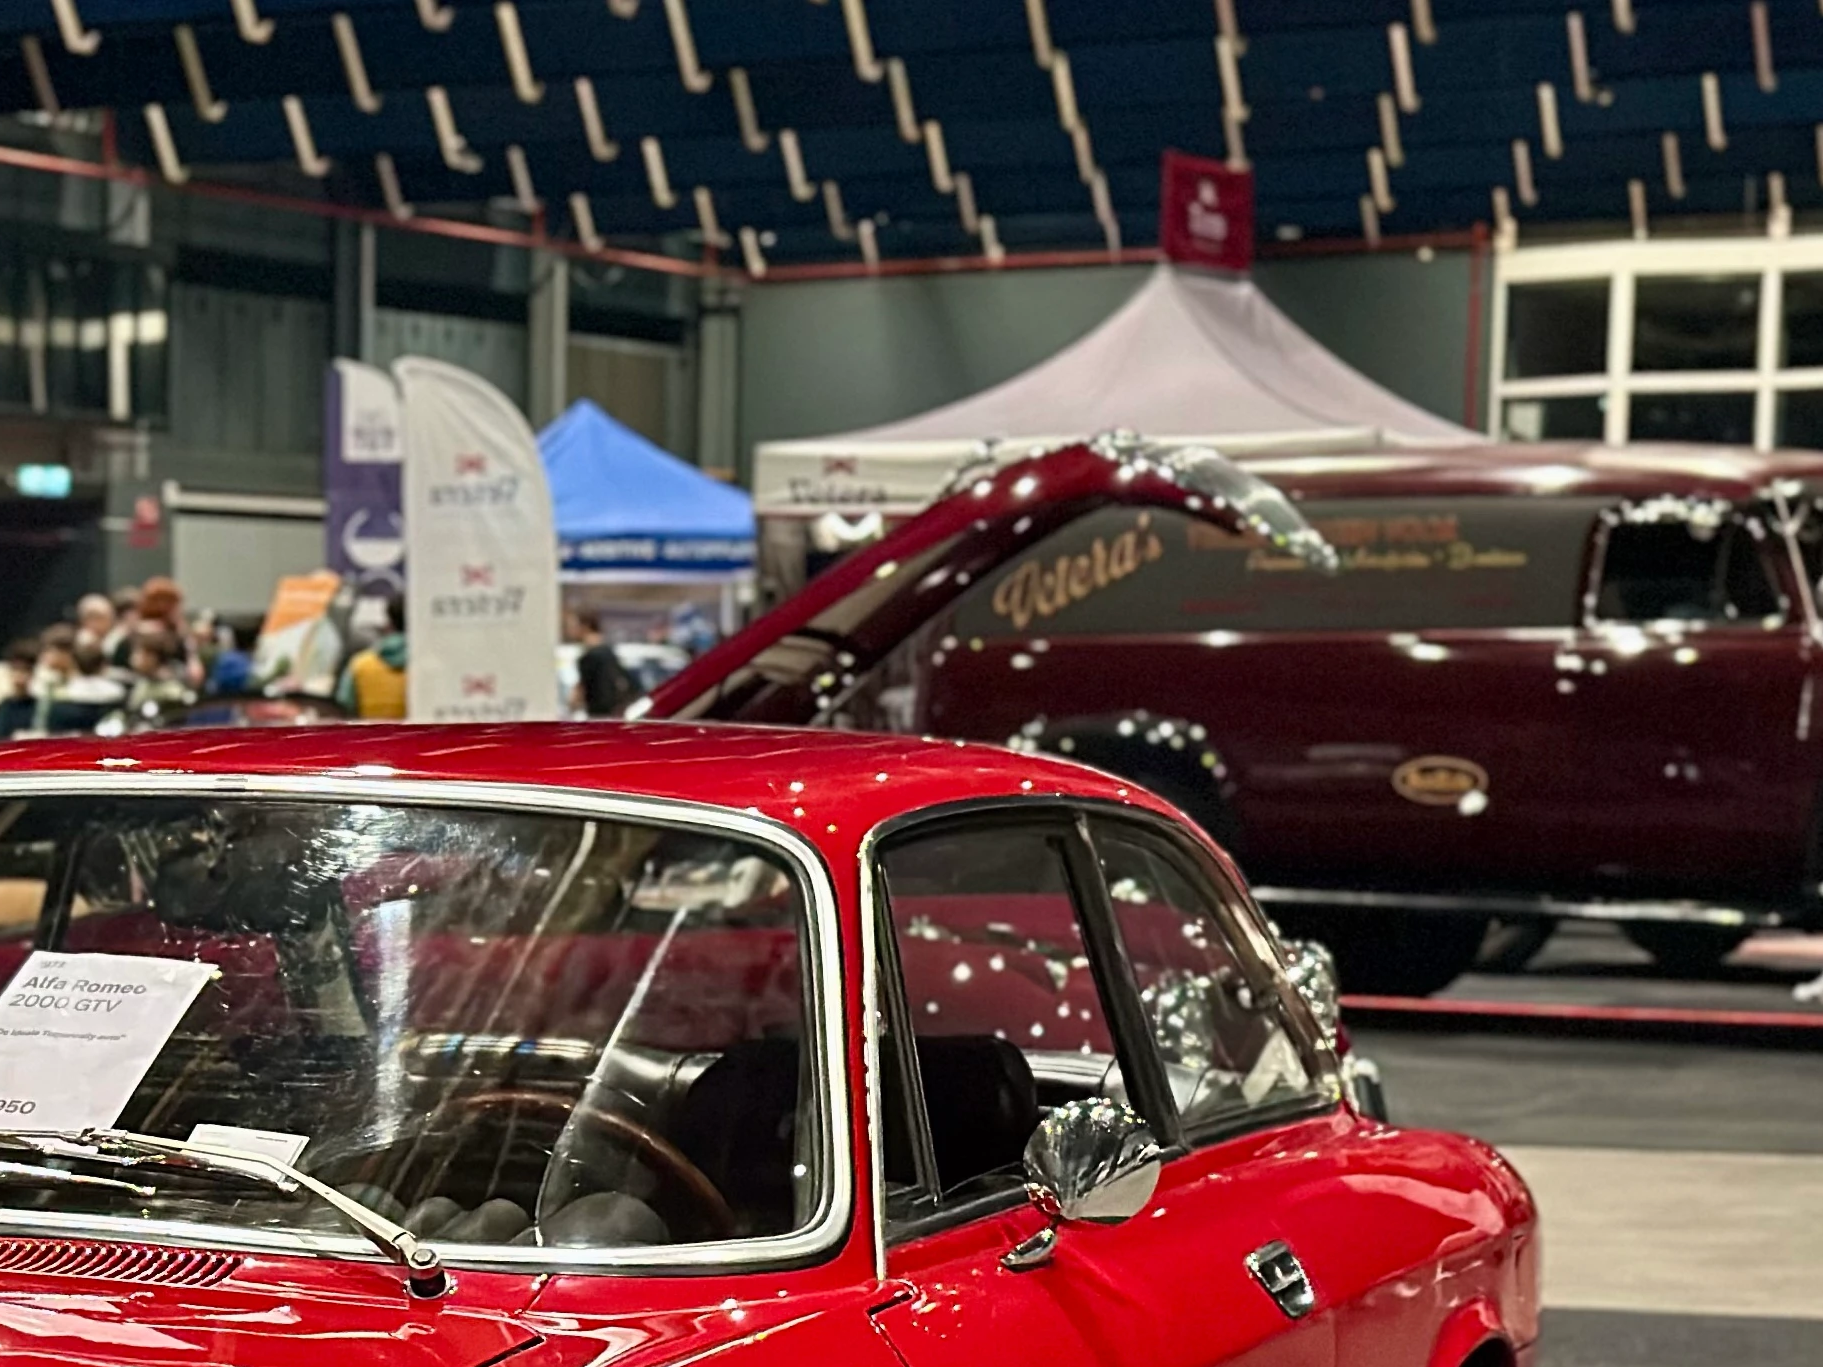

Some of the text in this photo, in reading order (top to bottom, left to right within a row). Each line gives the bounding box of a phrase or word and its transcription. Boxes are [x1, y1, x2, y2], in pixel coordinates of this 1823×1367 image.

[22, 976, 147, 995] Alfa Romeo
[8, 993, 123, 1014] 2000 GTV
